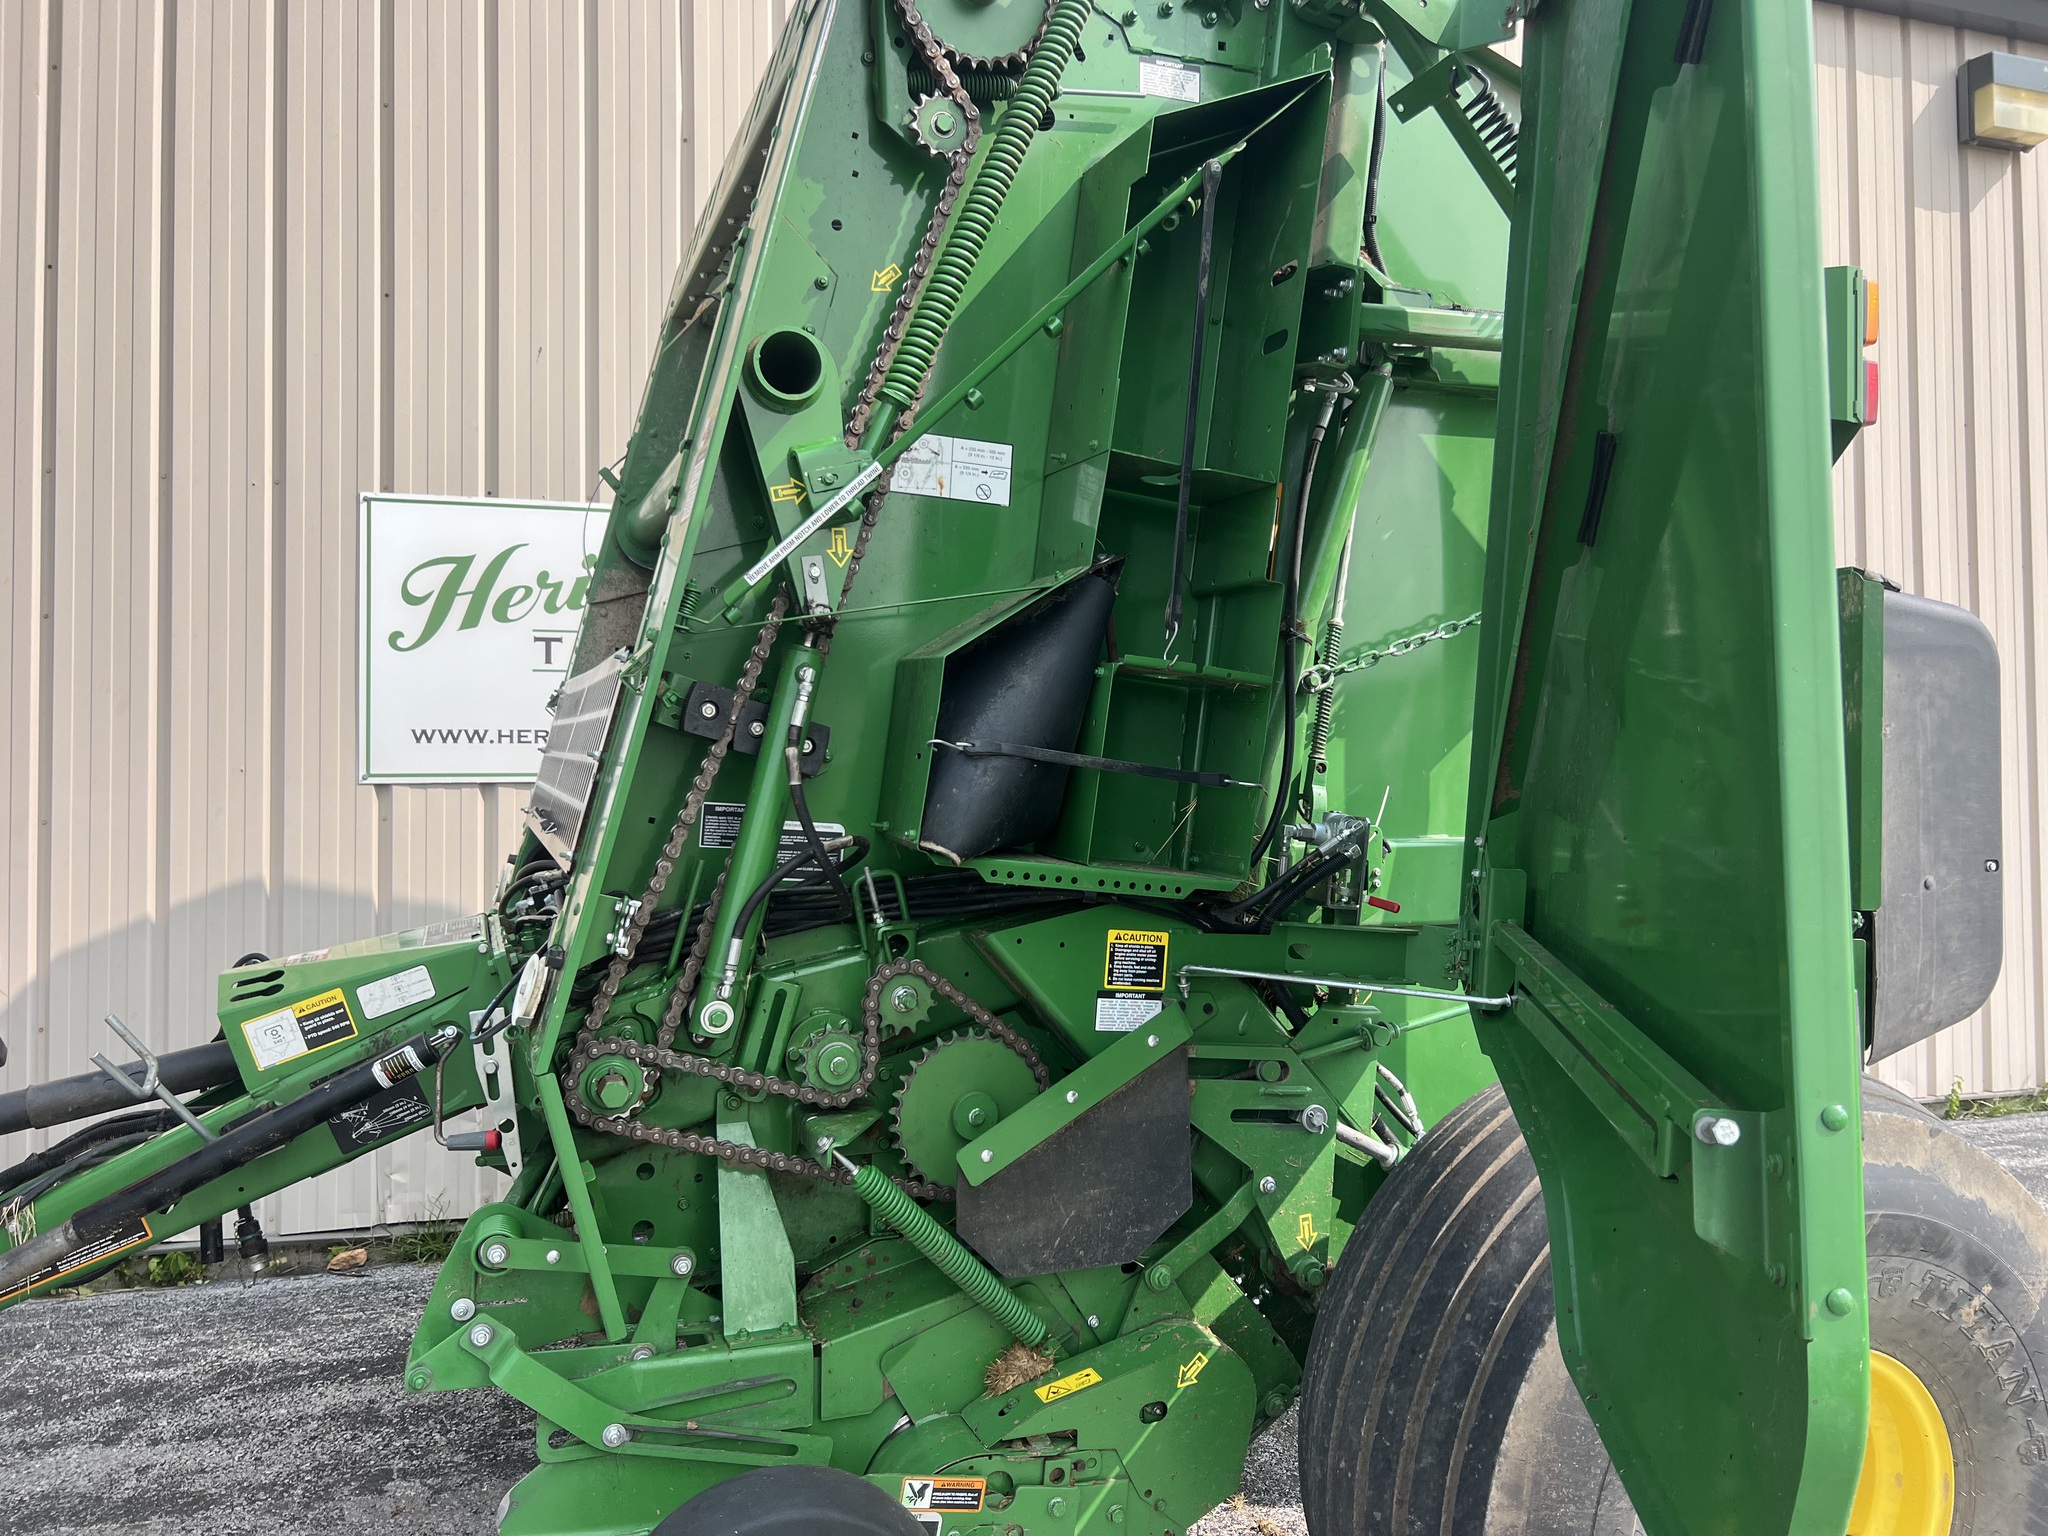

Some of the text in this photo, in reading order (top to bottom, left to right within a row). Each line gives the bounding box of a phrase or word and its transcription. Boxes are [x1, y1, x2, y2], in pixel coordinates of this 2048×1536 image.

[1156, 60, 1184, 69] IMPORTANT
[746, 466, 881, 582] REMOVE ARM FROM NOTCH AND LOWER TO THREAD TWINE
[1123, 934, 1163, 943] CAUTION
[306, 995, 337, 1010] CAUTION
[1911, 1269, 2042, 1406] TITAN
